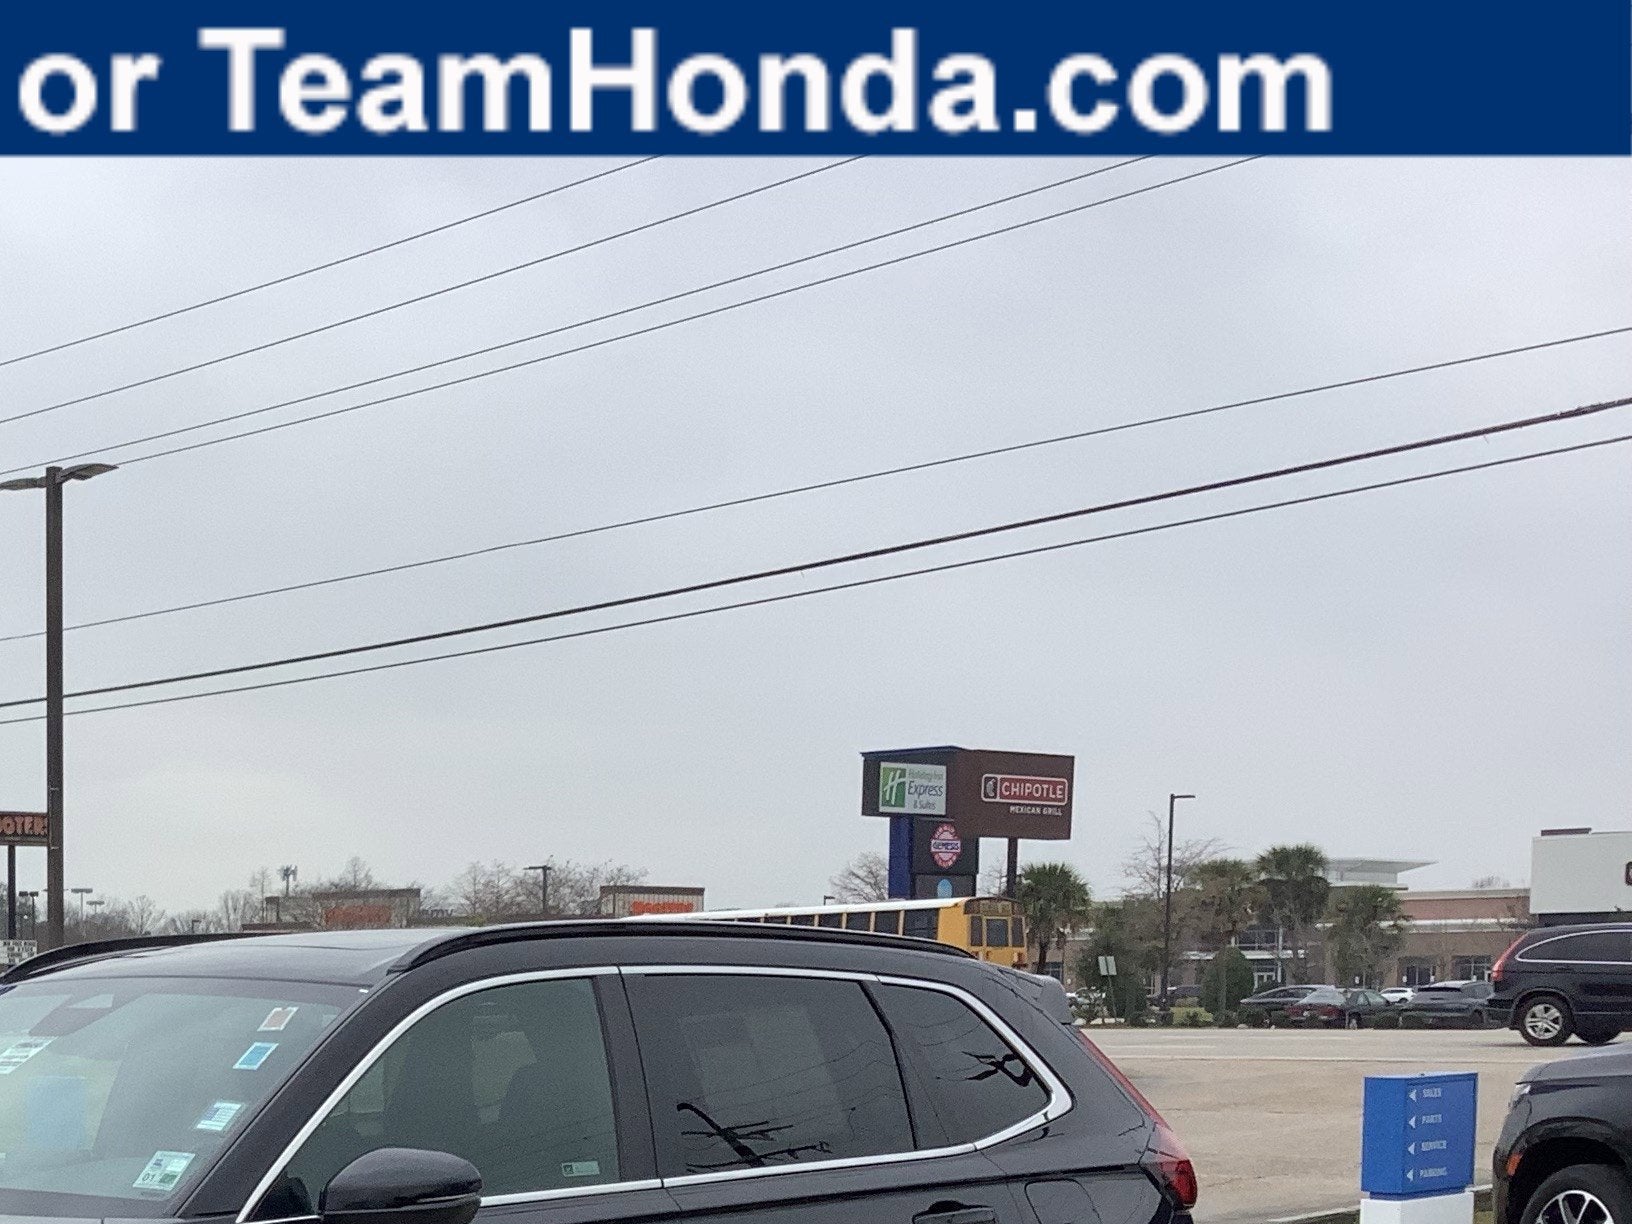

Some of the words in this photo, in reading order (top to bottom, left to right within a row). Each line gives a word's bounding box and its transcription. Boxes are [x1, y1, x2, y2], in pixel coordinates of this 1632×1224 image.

[907, 780, 944, 799] Express
[1001, 781, 1064, 799] CHIPOTLE
[1010, 805, 1041, 814] MEXICAN
[1043, 807, 1062, 816] GRILL
